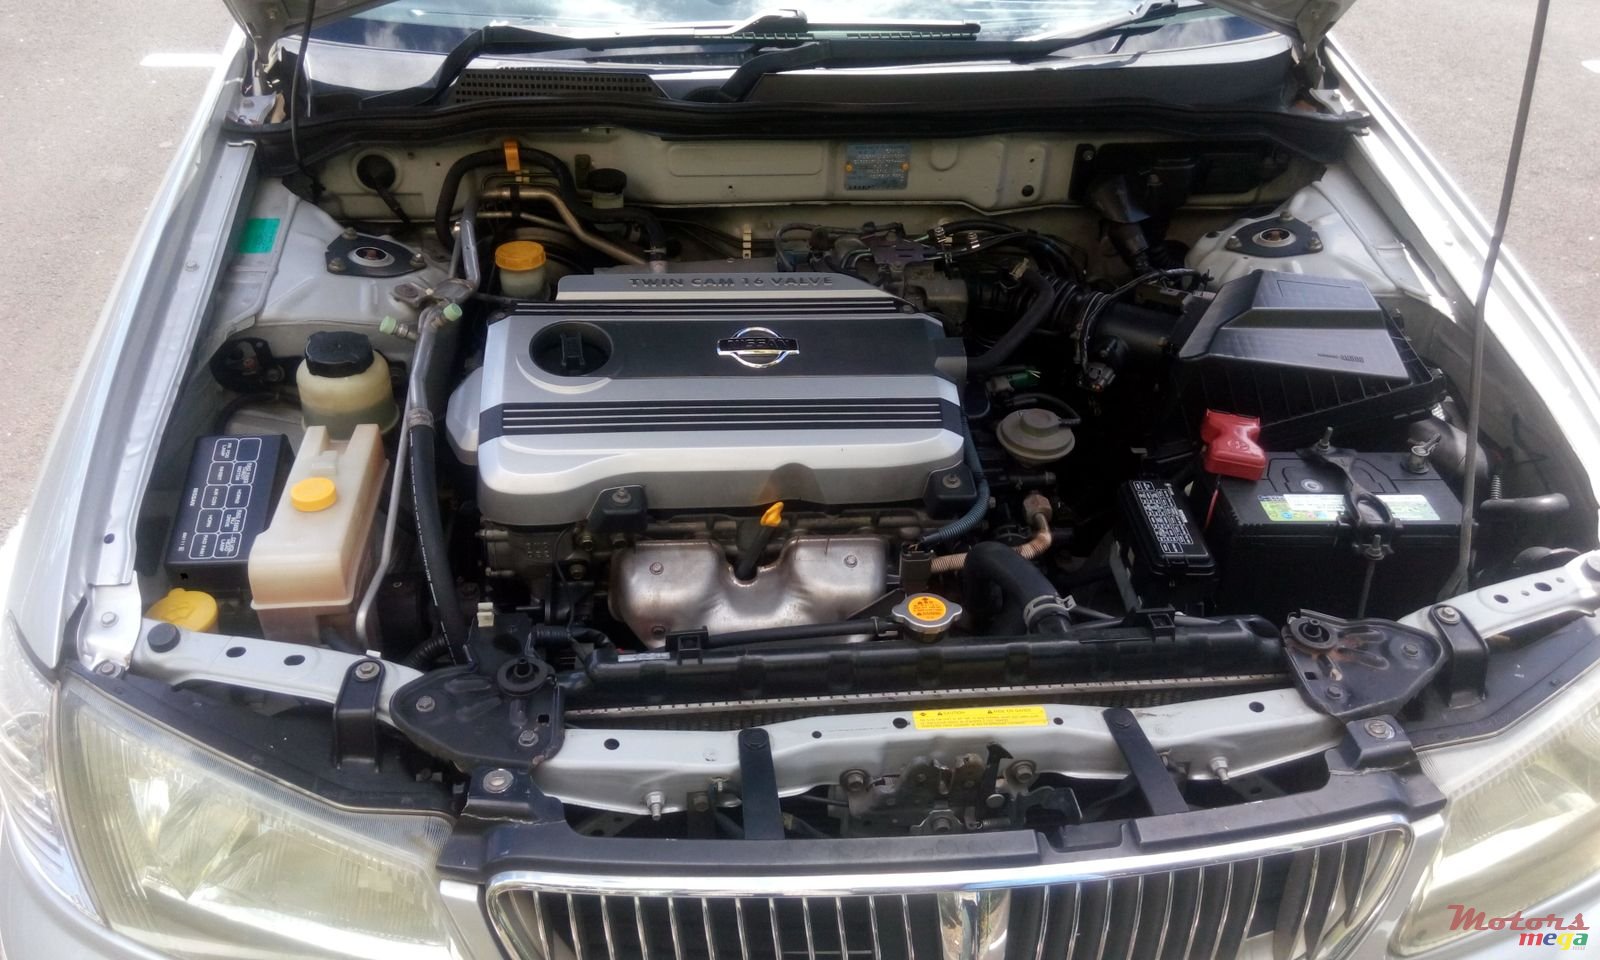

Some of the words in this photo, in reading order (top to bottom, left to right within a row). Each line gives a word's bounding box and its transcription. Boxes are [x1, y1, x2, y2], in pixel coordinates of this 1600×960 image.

[629, 277, 685, 287] TWIN
[691, 277, 735, 287] CAM
[741, 277, 765, 287] 16
[770, 276, 834, 286] VALVE
[727, 338, 790, 348] NISSAN
